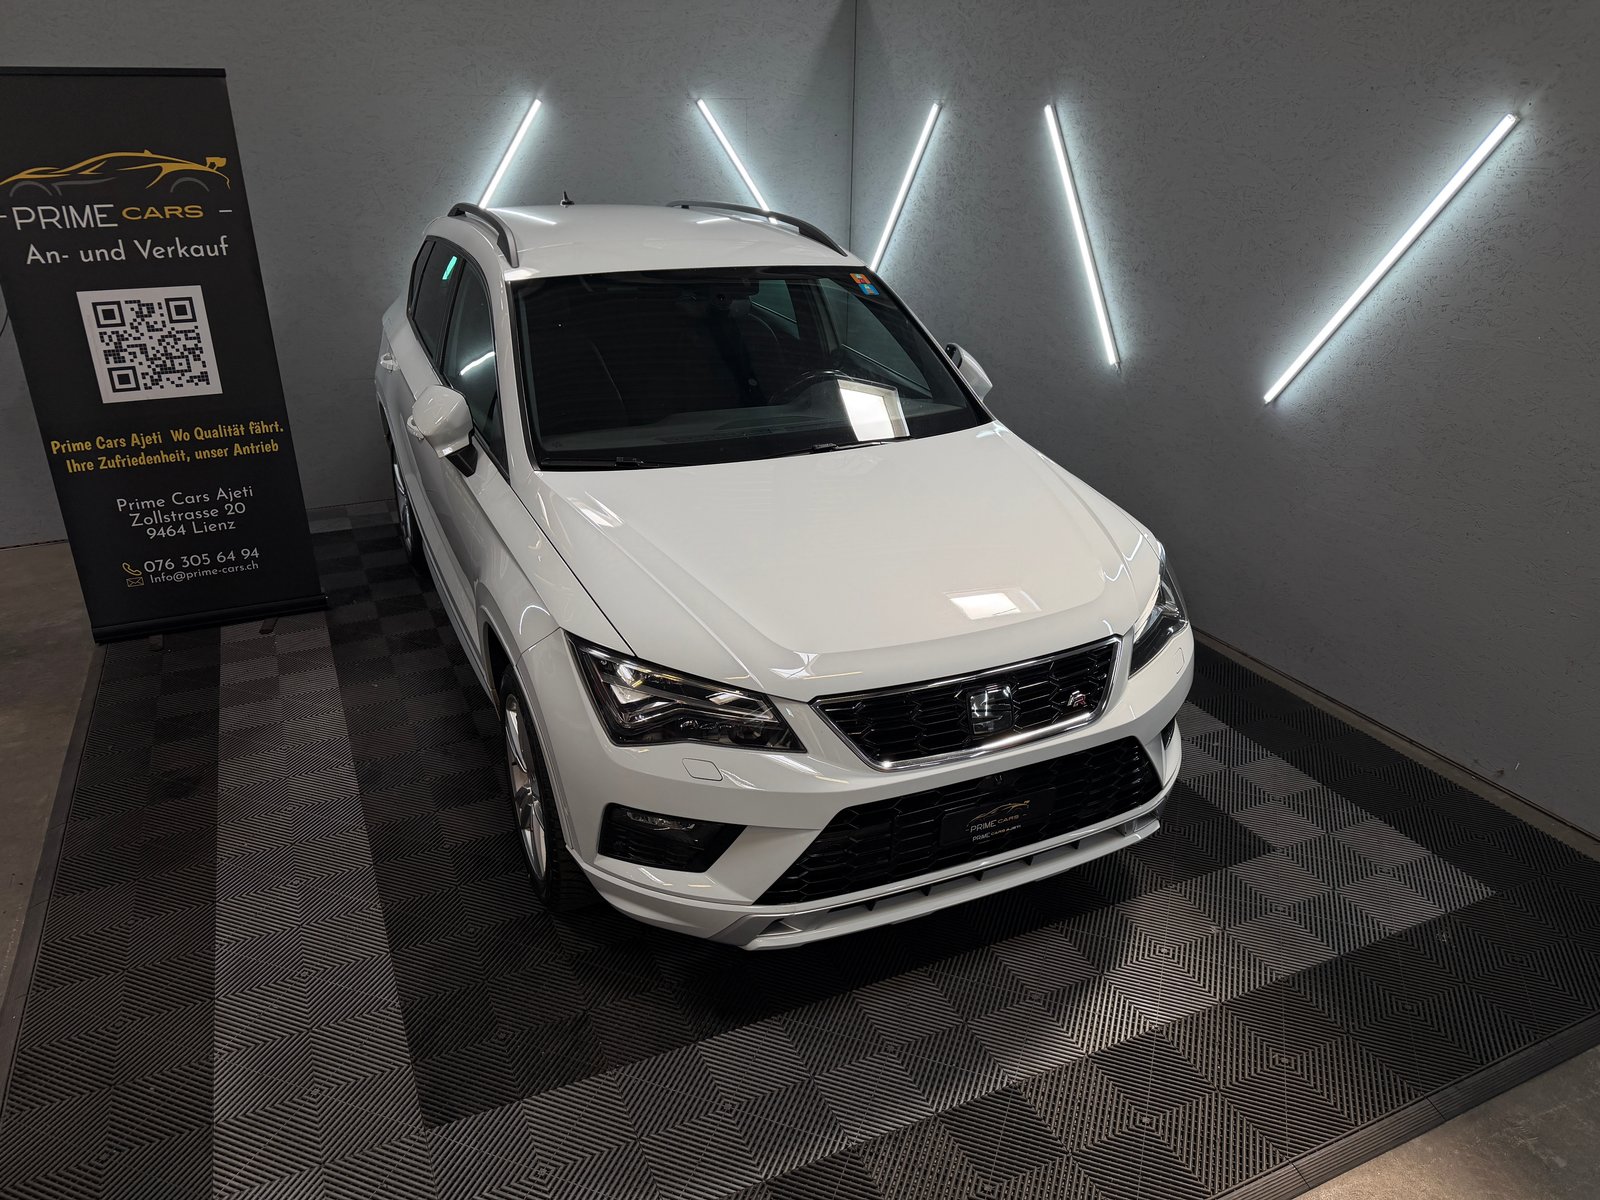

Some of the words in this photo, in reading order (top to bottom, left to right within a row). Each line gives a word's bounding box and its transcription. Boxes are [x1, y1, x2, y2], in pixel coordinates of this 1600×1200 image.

[12, 204, 118, 230] PRIME
[121, 205, 204, 220] CARS
[26, 244, 69, 265] An-
[79, 239, 126, 263] und
[133, 235, 229, 260] Verkauf
[51, 438, 92, 454] Prime
[96, 435, 127, 450] Cars
[130, 431, 163, 449] Ajeti
[170, 429, 191, 443] Wo
[194, 425, 246, 442] Qualität
[249, 420, 284, 436] fährt.
[66, 457, 94, 473] Ihre
[98, 451, 191, 470] Zufriedenheit,
[195, 447, 229, 460] unser
[233, 440, 279, 456] Antrieb
[116, 497, 166, 512] Prime
[171, 490, 210, 506] Cars
[216, 486, 253, 503] Ajeti
[129, 508, 219, 527] Zollstrasse
[225, 502, 246, 516] 20
[146, 524, 187, 540] 9464
[192, 520, 236, 535] Lienz
[143, 557, 175, 574] 076
[181, 553, 211, 569] 305
[216, 551, 235, 564] 64
[241, 547, 260, 560] 94
[150, 561, 259, 584] Info@prime-cars.ch
[970, 820, 997, 832] PRIME
